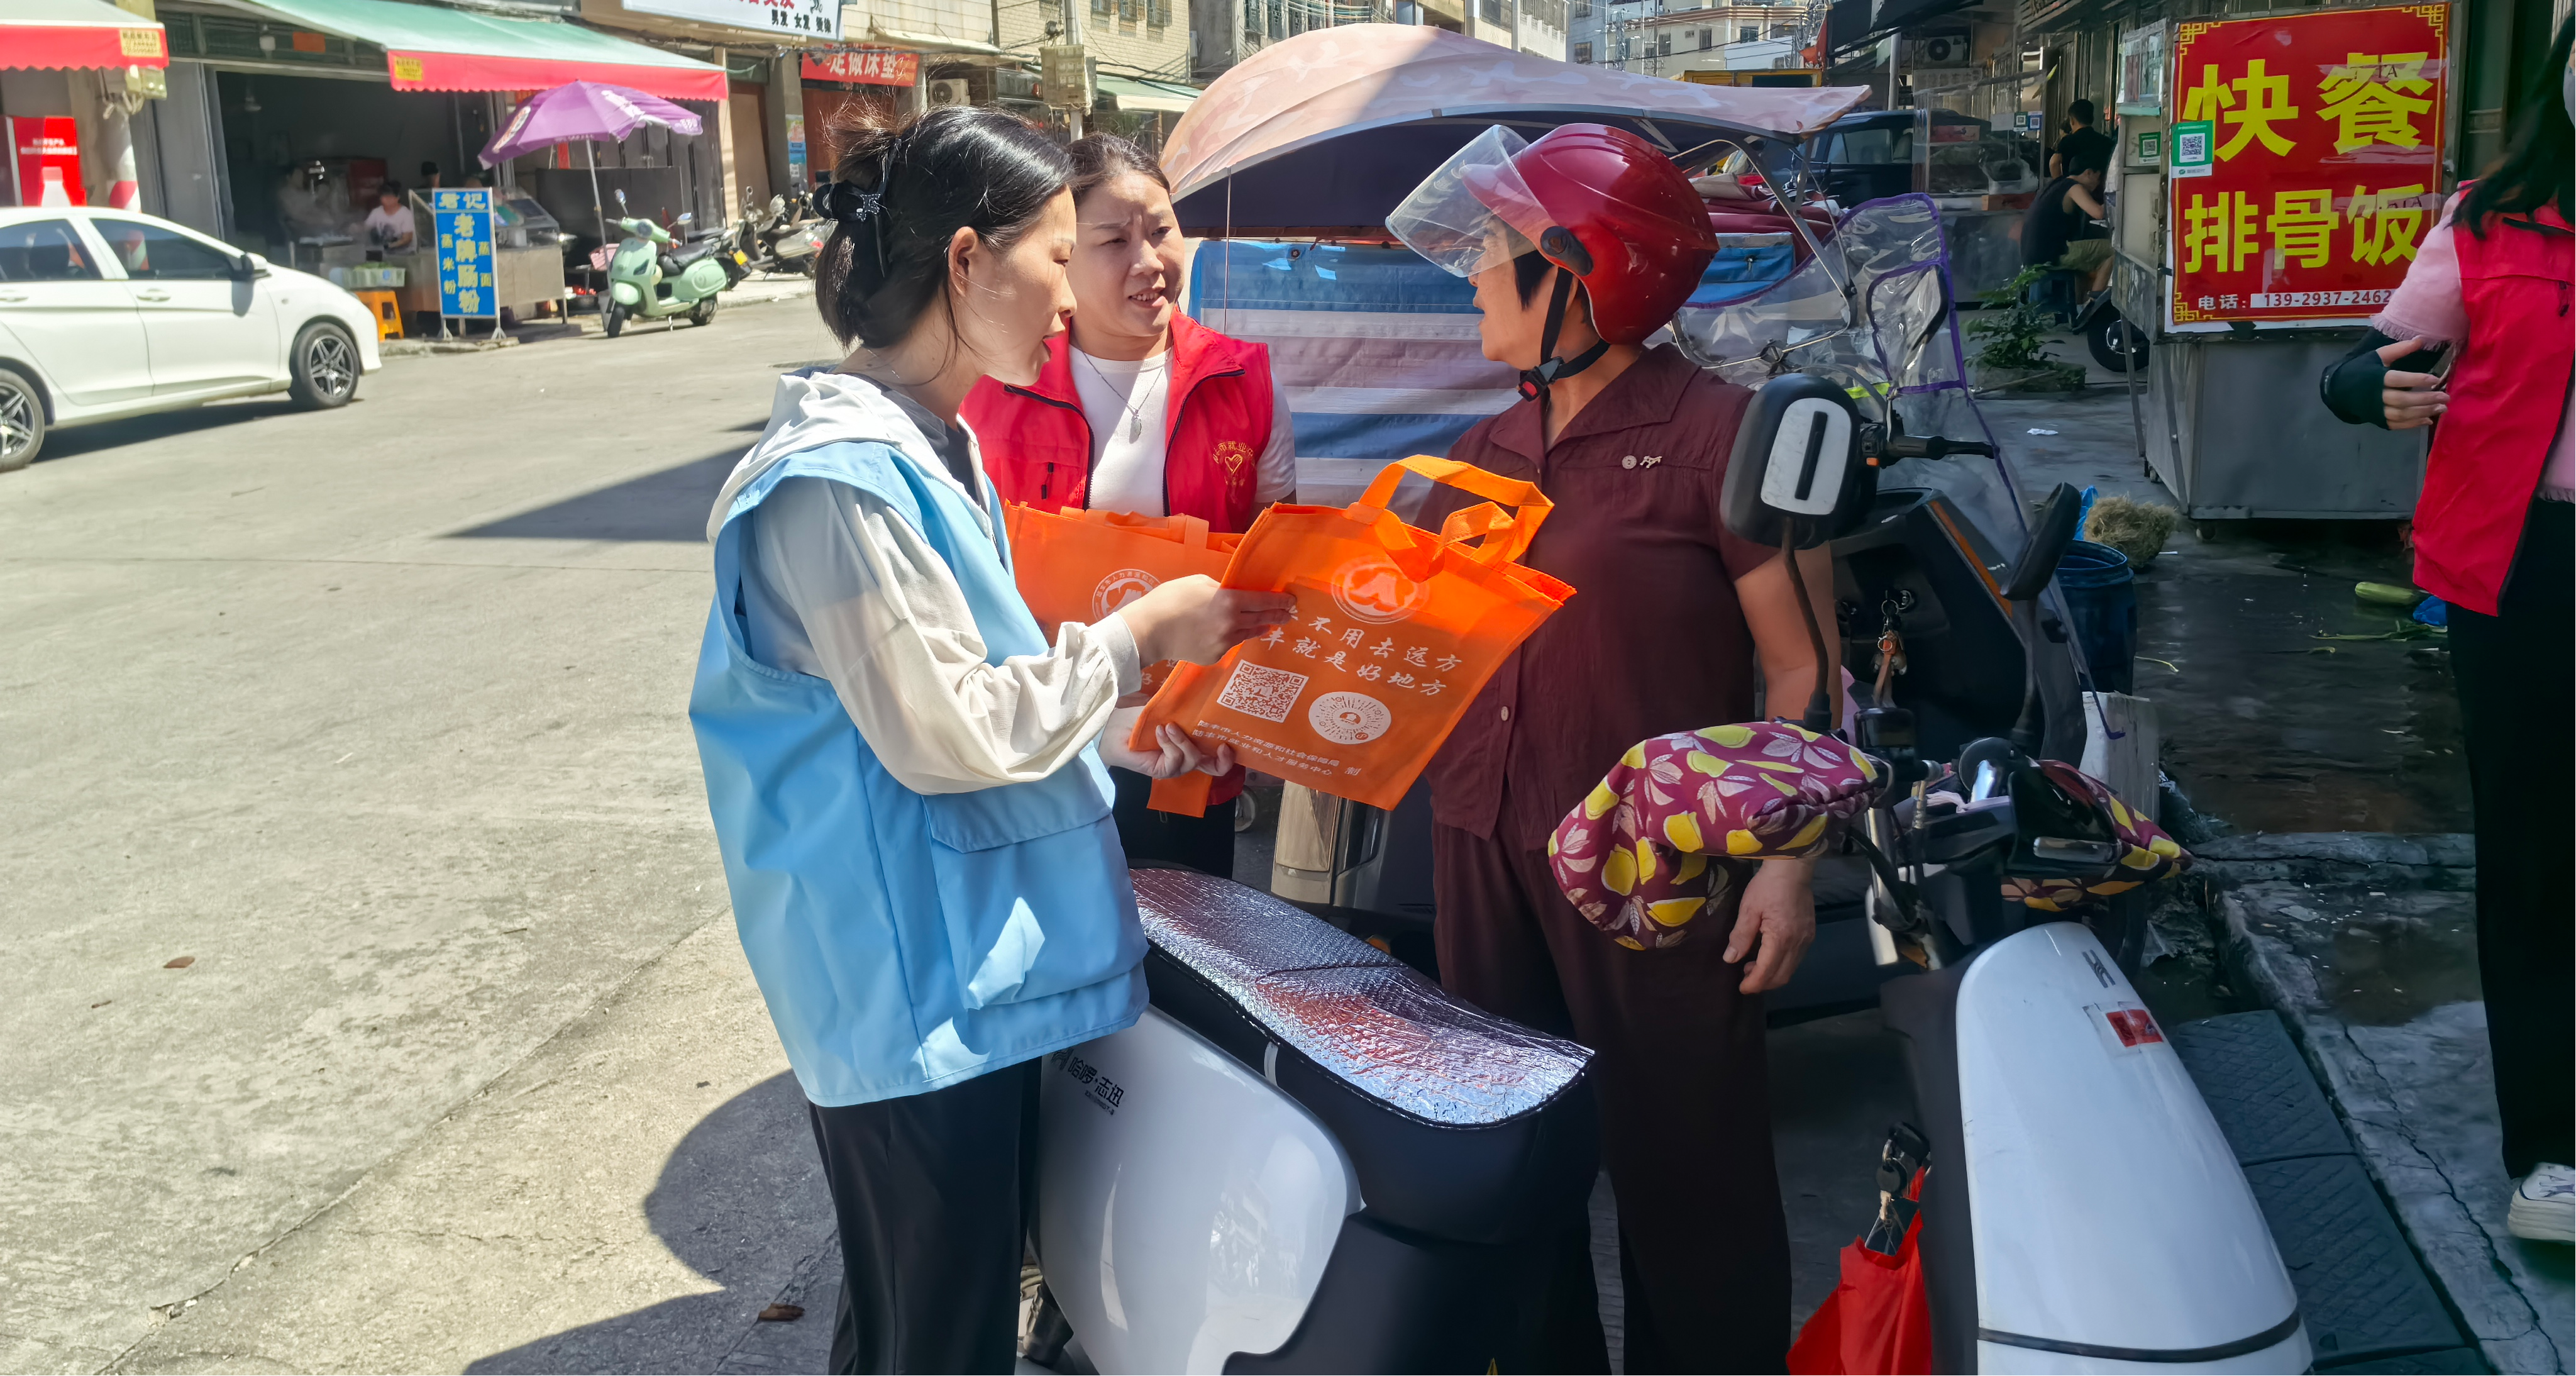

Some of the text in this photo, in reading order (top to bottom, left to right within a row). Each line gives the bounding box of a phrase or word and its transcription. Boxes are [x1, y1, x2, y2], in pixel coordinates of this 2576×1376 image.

[771, 9, 788, 27] 男发
[794, 13, 810, 31] 女发
[2182, 52, 2433, 162] 快餐
[2184, 183, 2425, 274] 排骨饭
[454, 213, 480, 313] 老牌肠粉
[2264, 290, 2392, 307] 139-2937-2462
[1096, 571, 1159, 597] 陆丰市人力资源和社
[1192, 729, 1332, 775] 陆丰市就业和人才服务中心
[1197, 720, 1340, 767] 陆丰市人力资源和社会保障局
